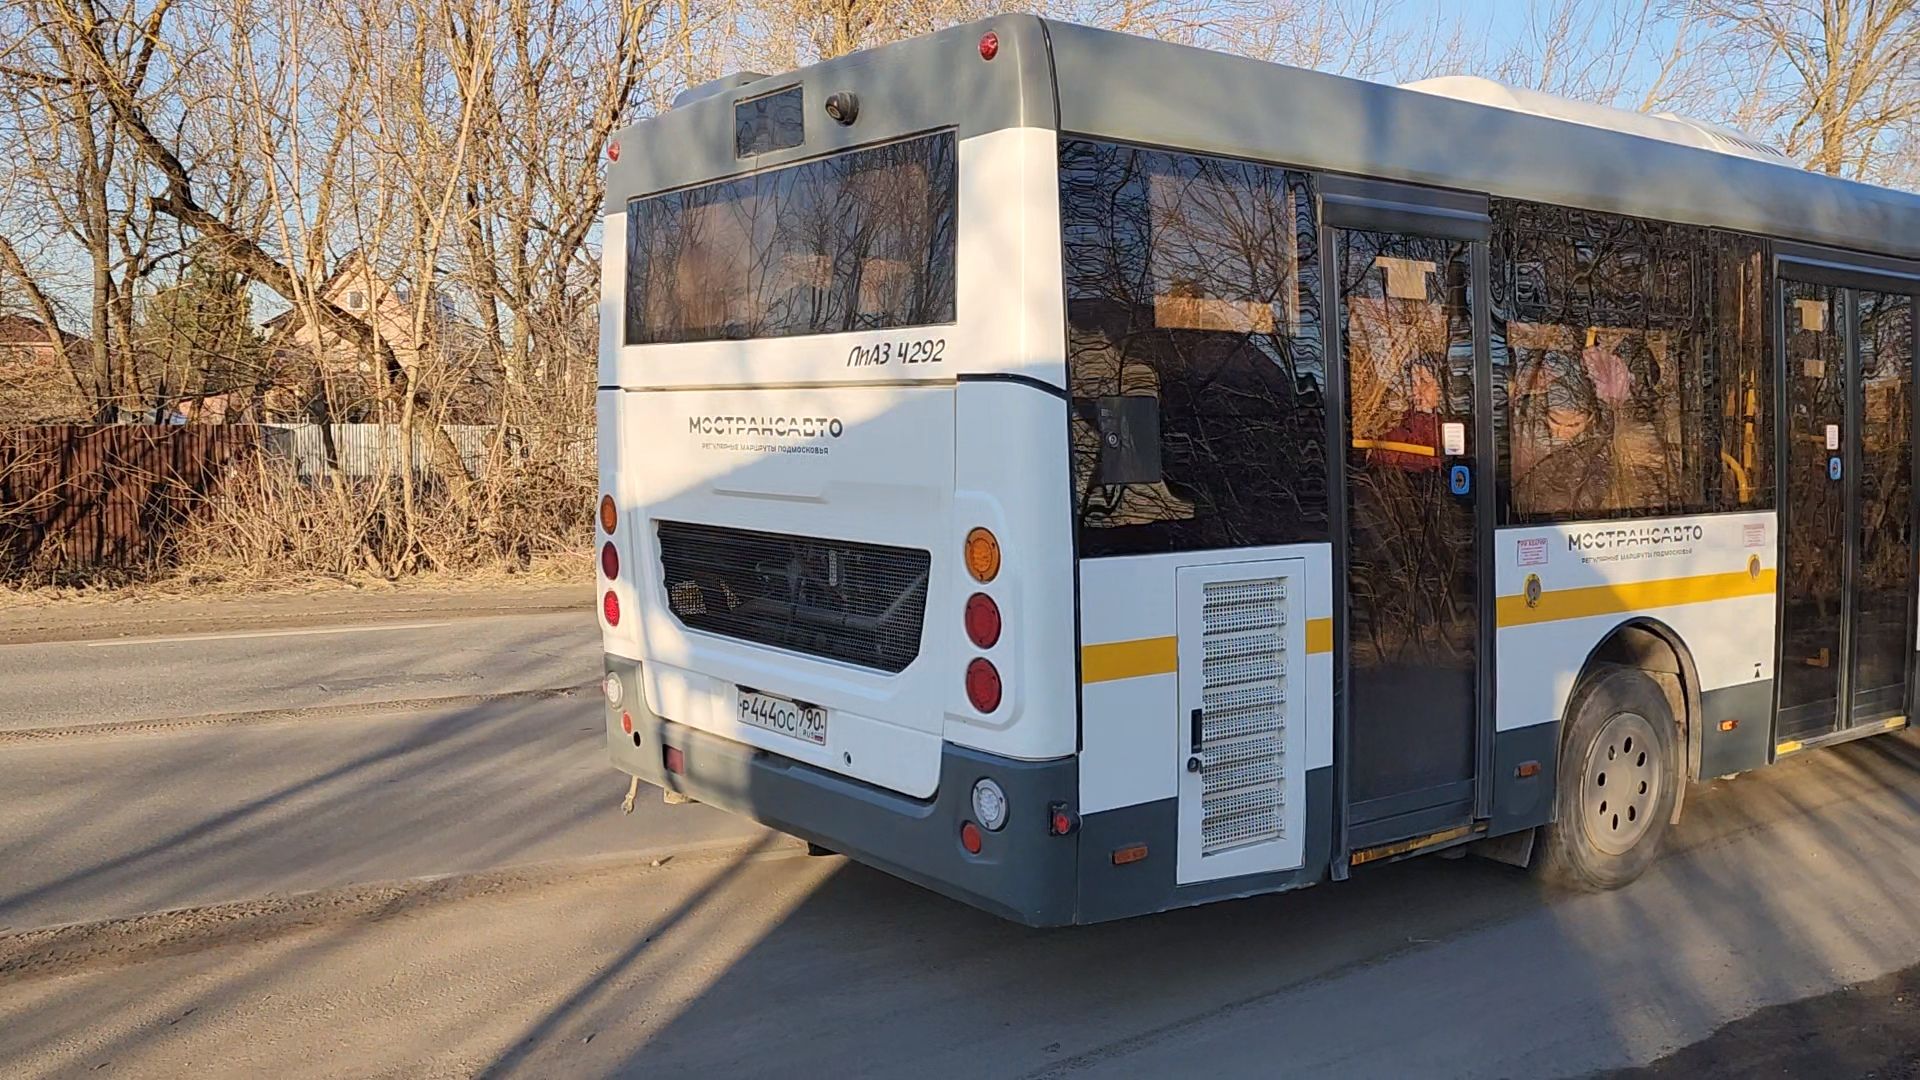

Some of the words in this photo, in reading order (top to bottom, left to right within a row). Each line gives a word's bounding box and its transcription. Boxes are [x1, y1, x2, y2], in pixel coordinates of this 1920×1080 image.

[898, 339, 946, 364] 4292
[689, 416, 843, 438] МОСТРАНСАВТО
[778, 445, 829, 455] ПОДМОСКОВЬЯ
[1568, 525, 1703, 551] МОСТРАНСАВТО
